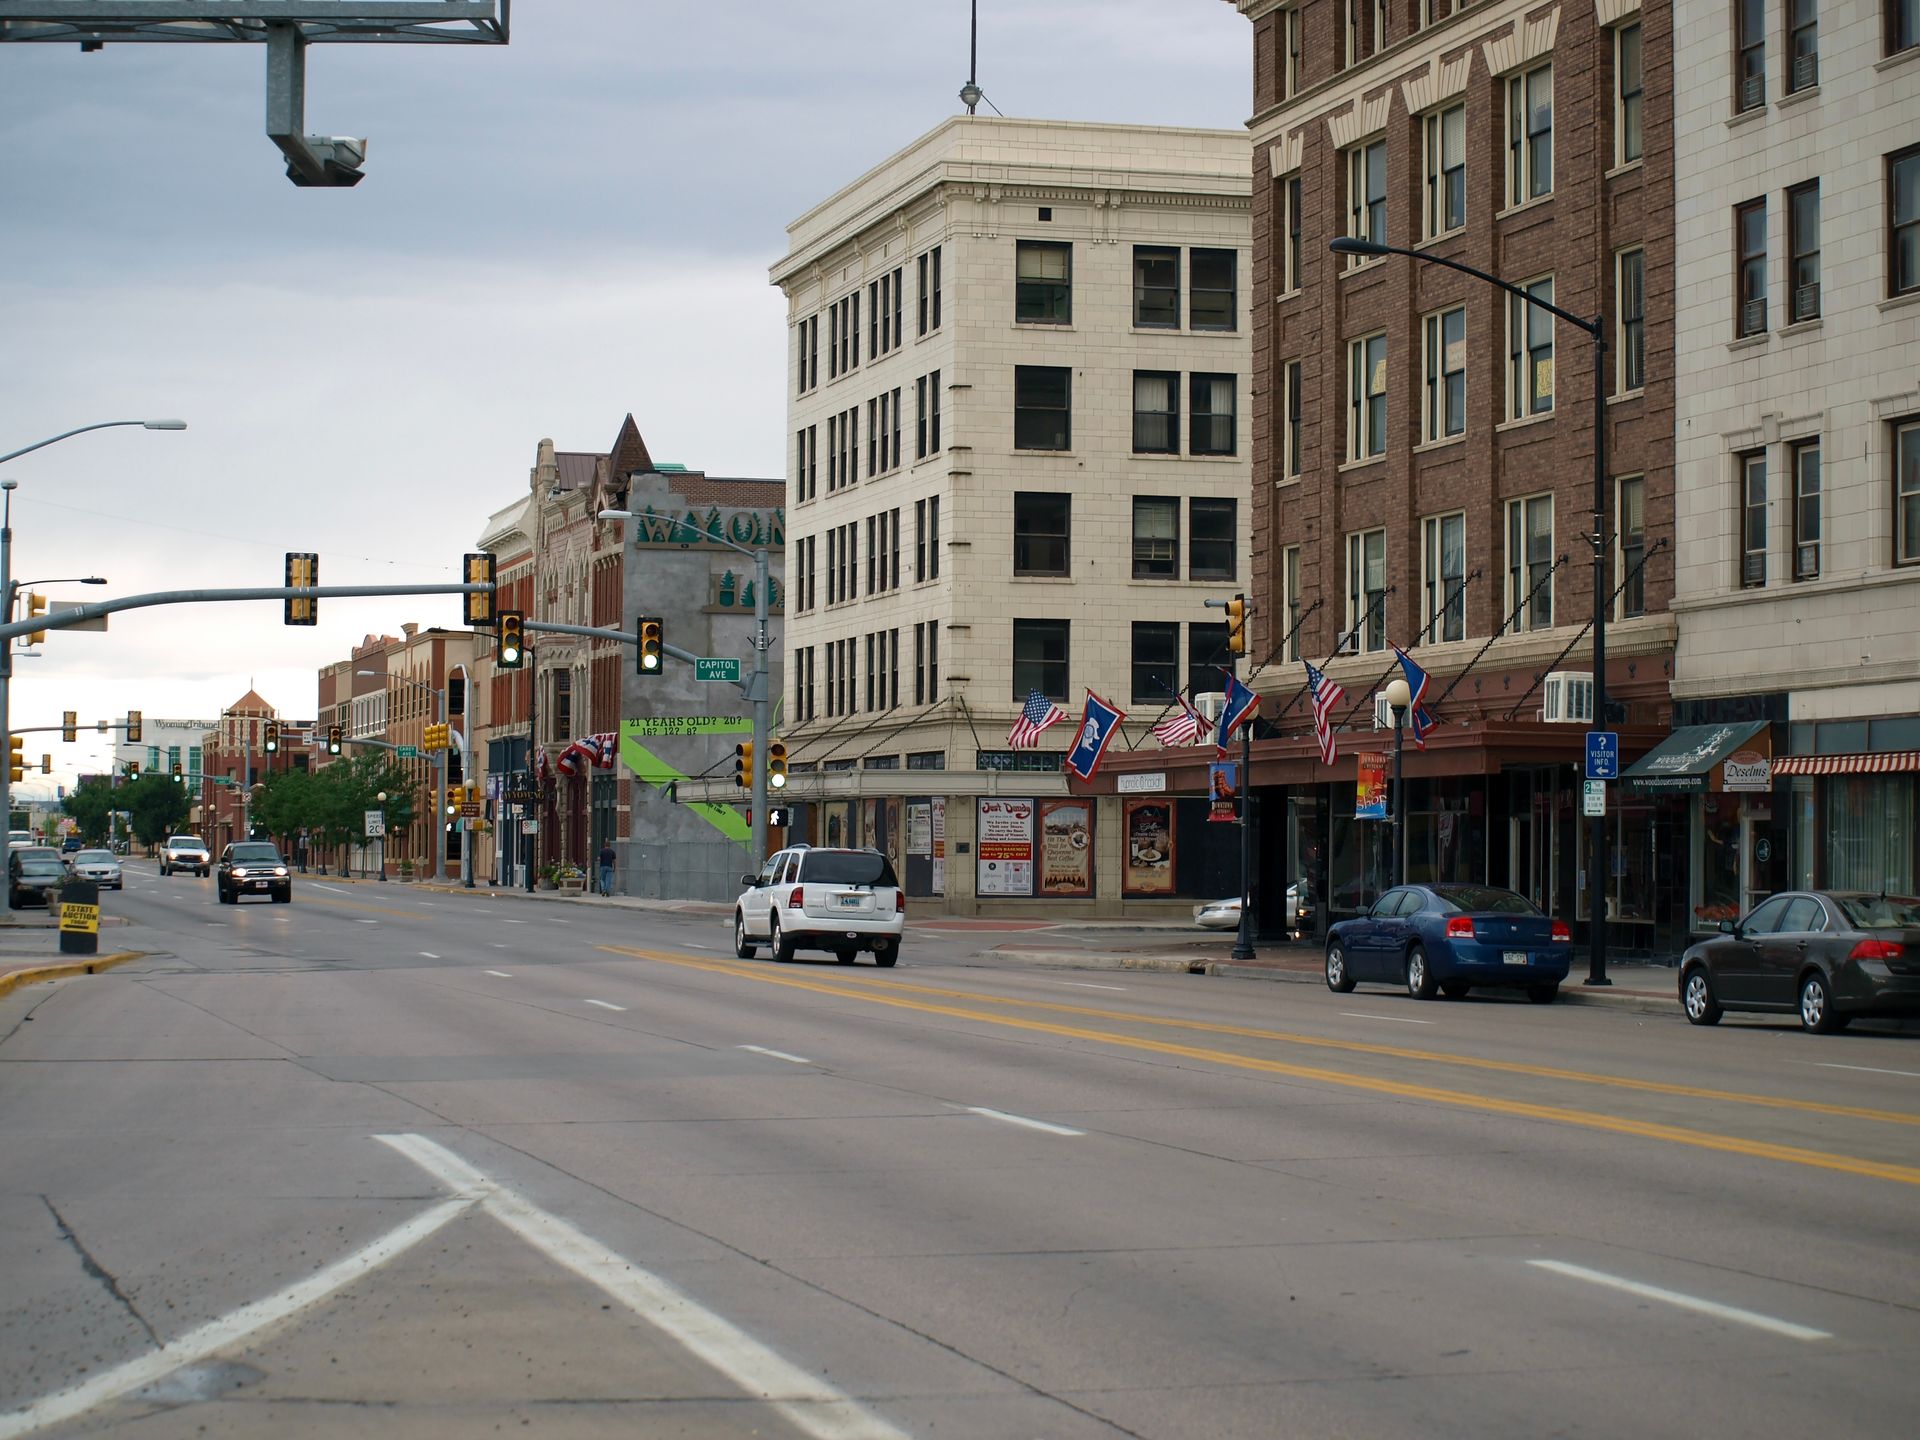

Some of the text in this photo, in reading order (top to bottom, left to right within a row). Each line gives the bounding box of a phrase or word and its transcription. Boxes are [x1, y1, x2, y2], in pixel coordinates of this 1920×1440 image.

[700, 661, 735, 669] CAPITOL
[630, 716, 742, 727] 21 YEARS OLD? 20?
[642, 727, 697, 736] 16? 12? 8?
[1727, 764, 1767, 776] Deselms
[1586, 784, 1591, 792] 2
[67, 905, 93, 913] ESTATE
[63, 912, 96, 920] AUCTION
